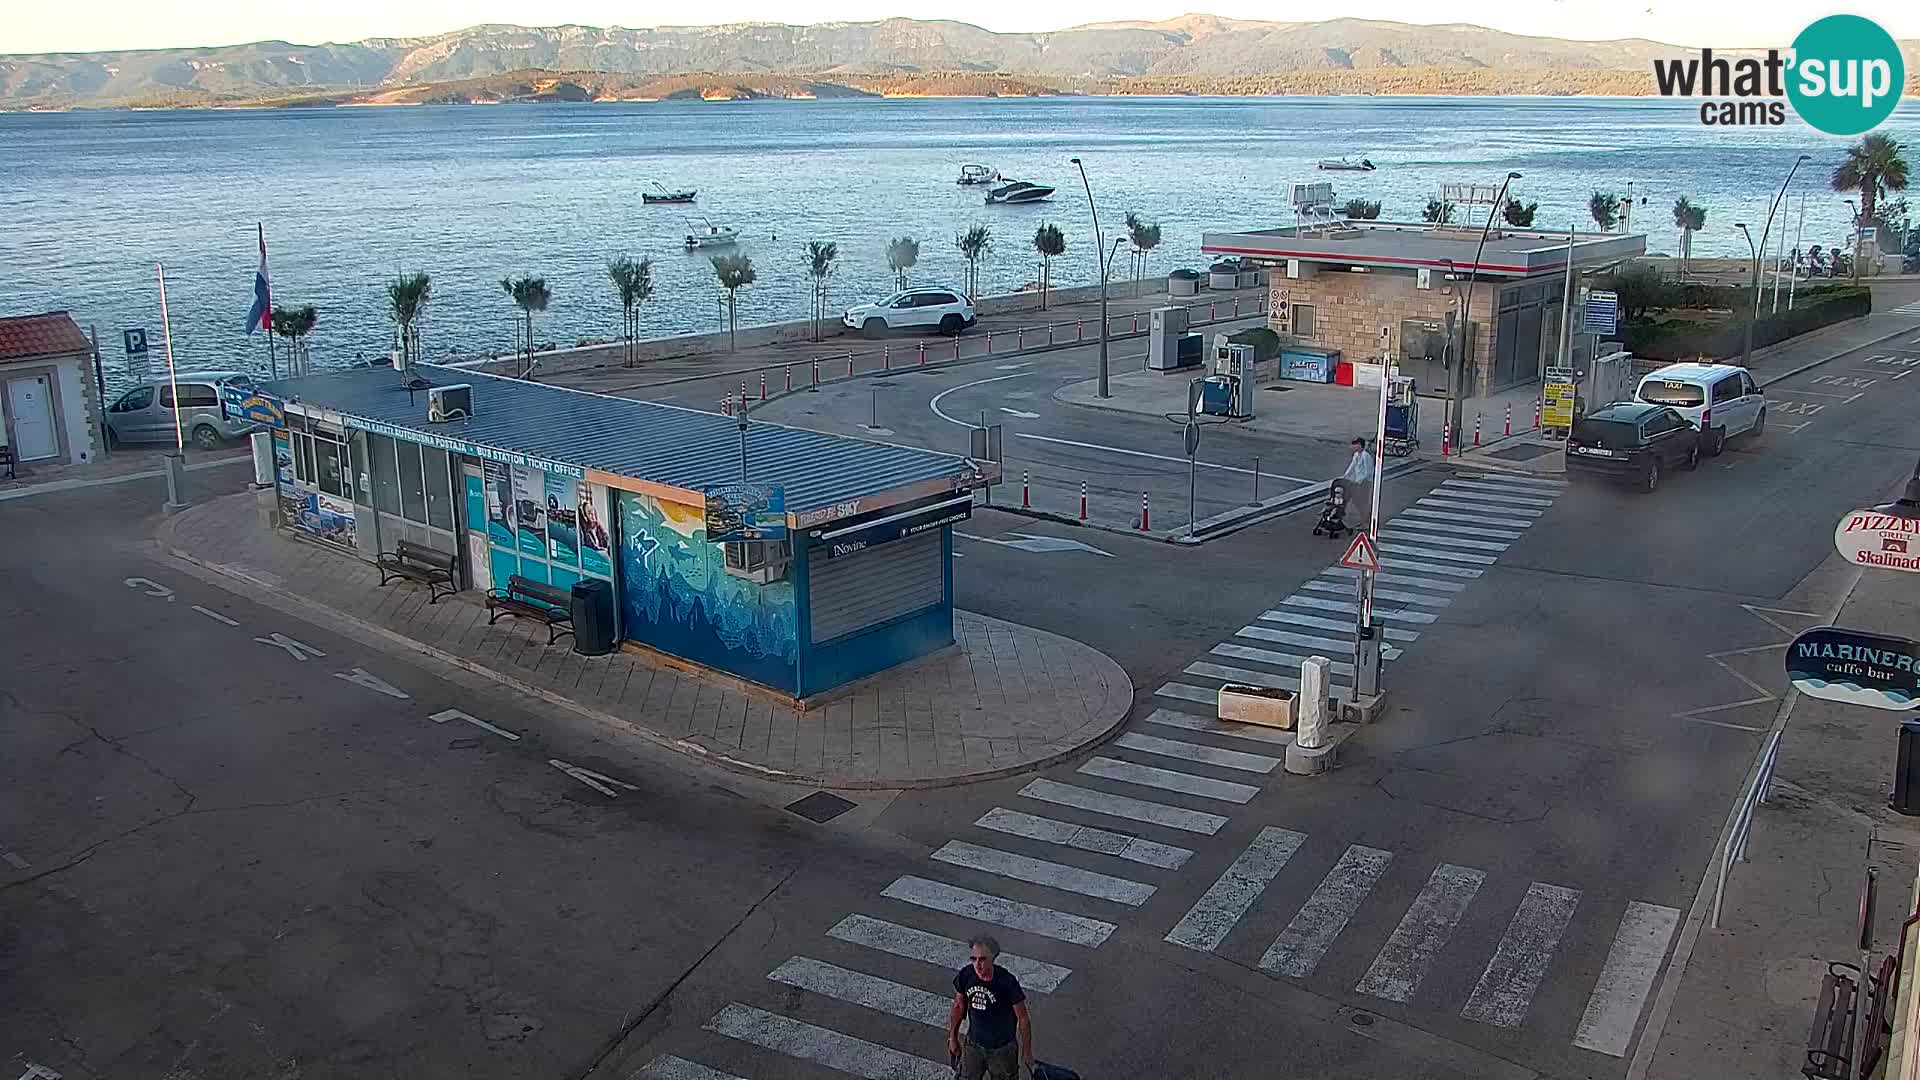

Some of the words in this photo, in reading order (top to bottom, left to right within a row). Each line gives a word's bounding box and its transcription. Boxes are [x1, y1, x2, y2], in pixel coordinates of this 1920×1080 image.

[128, 332, 142, 350] P
[1664, 381, 1683, 389] TAXI
[1810, 375, 1878, 389] TAXI
[435, 438, 467, 452] POSTAJA
[477, 446, 491, 458] BUS
[493, 450, 524, 465] STATION
[526, 457, 553, 471] TICKET
[554, 463, 581, 478] OFFICE
[1879, 531, 1914, 541] GRILL
[1856, 550, 1920, 571] Skalinad
[1826, 662, 1863, 676] caffe
[1867, 666, 1895, 681] bar
